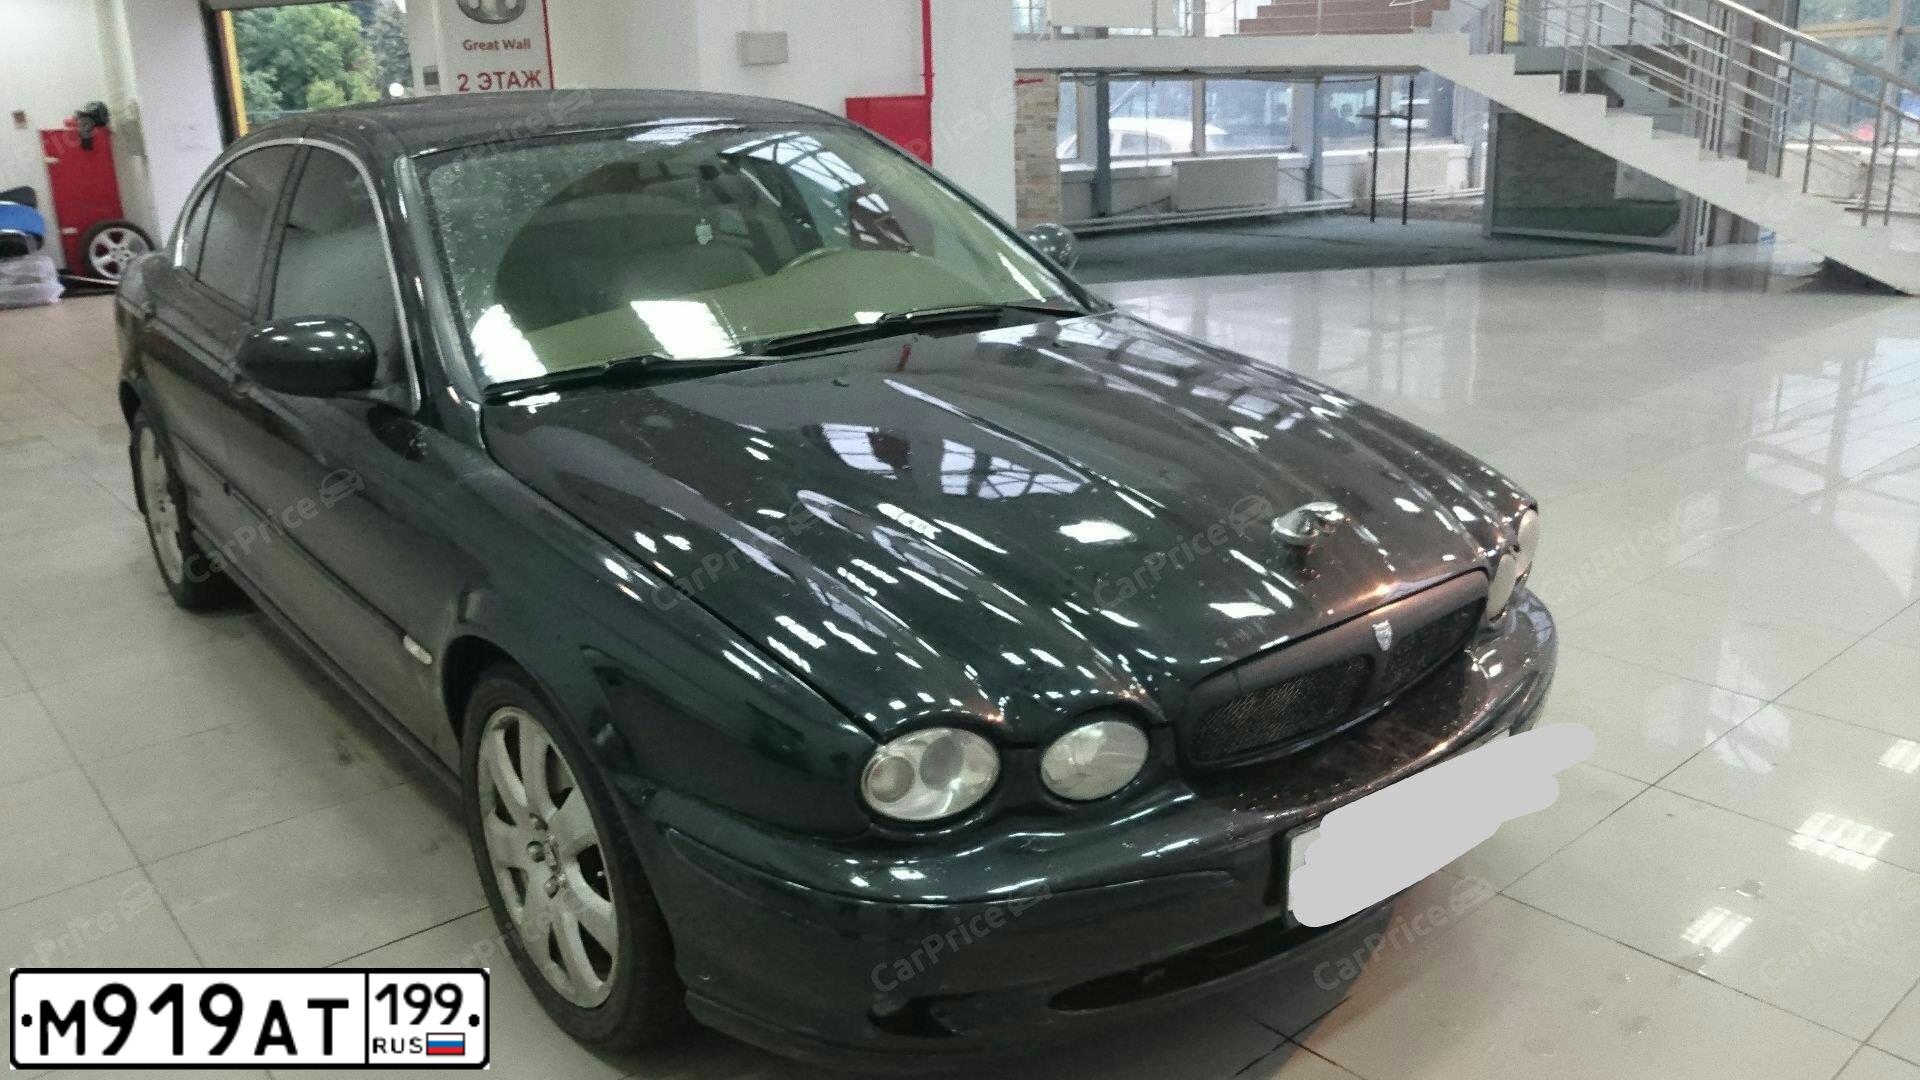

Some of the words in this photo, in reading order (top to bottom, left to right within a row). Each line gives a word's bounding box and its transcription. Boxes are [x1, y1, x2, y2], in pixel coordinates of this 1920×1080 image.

[463, 39, 500, 51] Great
[502, 38, 532, 50] Wall
[457, 74, 470, 92] 2
[476, 69, 543, 91] ЭТАЖ
